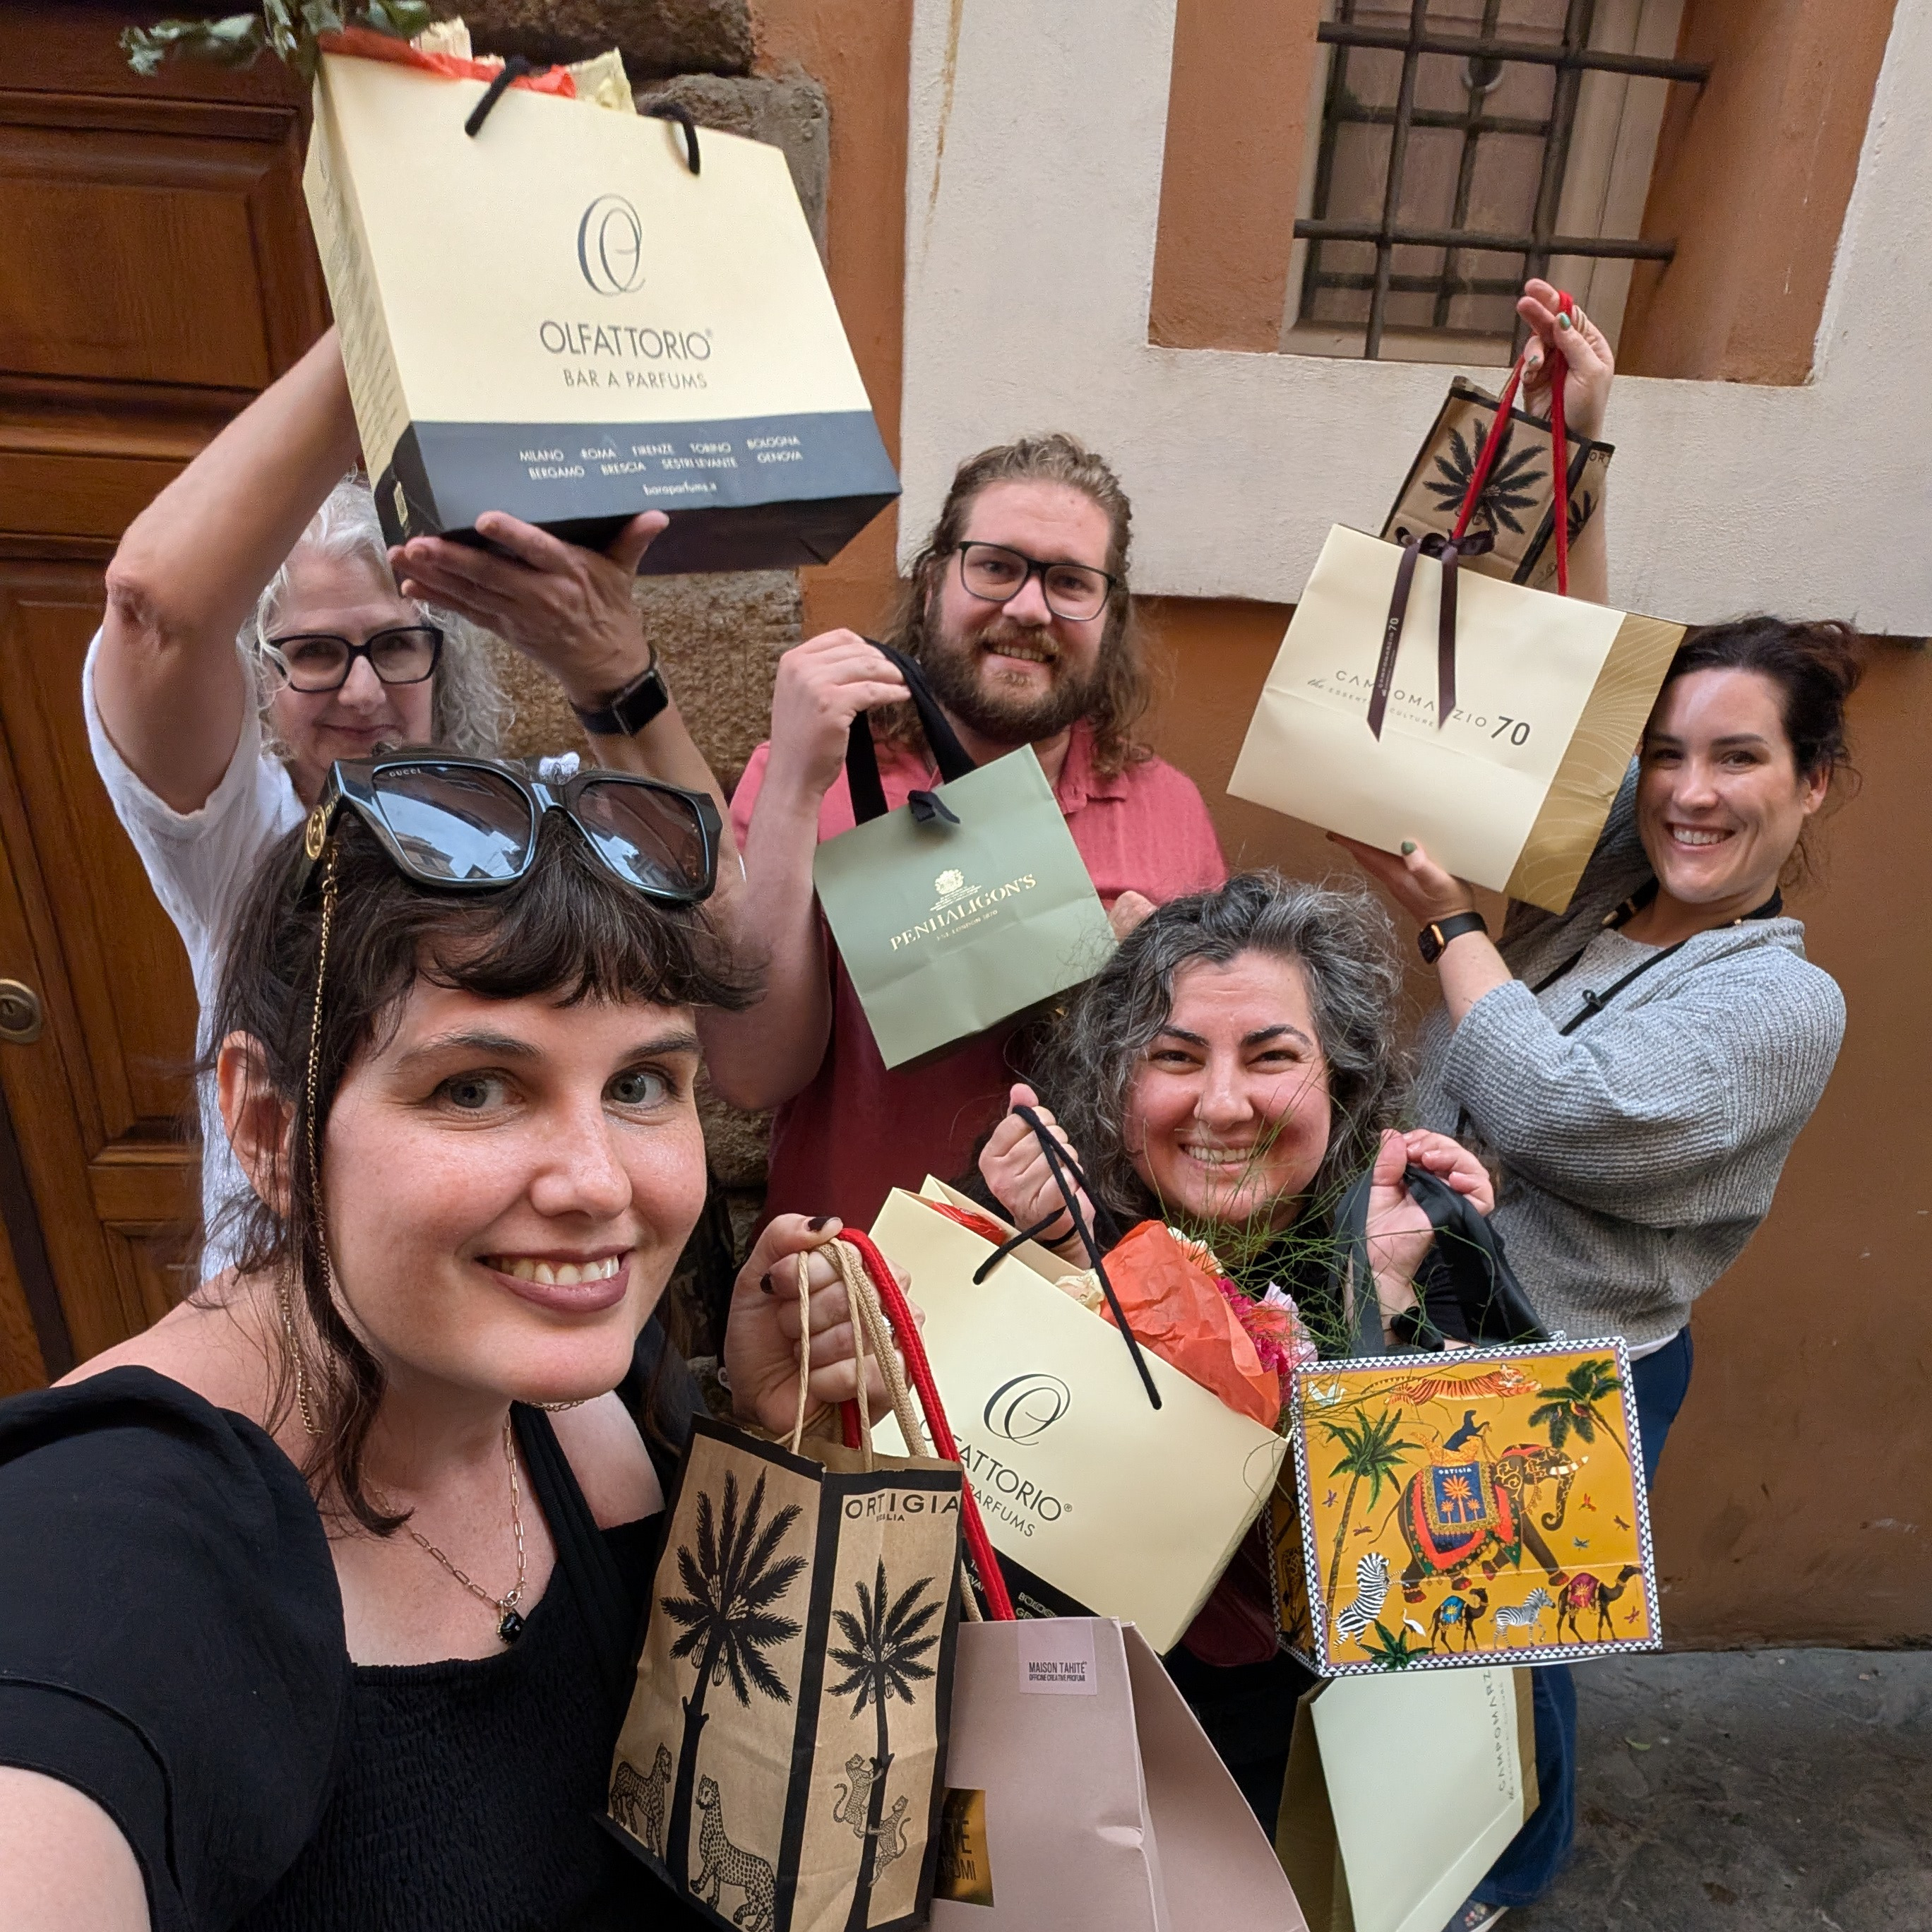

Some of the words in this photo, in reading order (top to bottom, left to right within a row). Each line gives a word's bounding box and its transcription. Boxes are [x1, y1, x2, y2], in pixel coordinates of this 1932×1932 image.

[564, 369, 600, 387] BAR
[608, 370, 620, 387] A
[626, 370, 707, 389] PARFUMS
[519, 448, 564, 462] MILANO
[527, 464, 585, 480] BERGAMO
[1388, 616, 1400, 631] 70
[1335, 670, 1487, 727] CAMOMAZIO
[1491, 715, 1531, 746] 70
[389, 768, 422, 777] GUCCI
[890, 873, 1037, 951] PENHALIGON'S
[845, 1493, 959, 1519] ORTIGIA
[1018, 1592, 1059, 1617] BOLOG
[1028, 1662, 1057, 1674] MAISON
[1484, 1669, 1506, 1791] CAMPOMARZ
